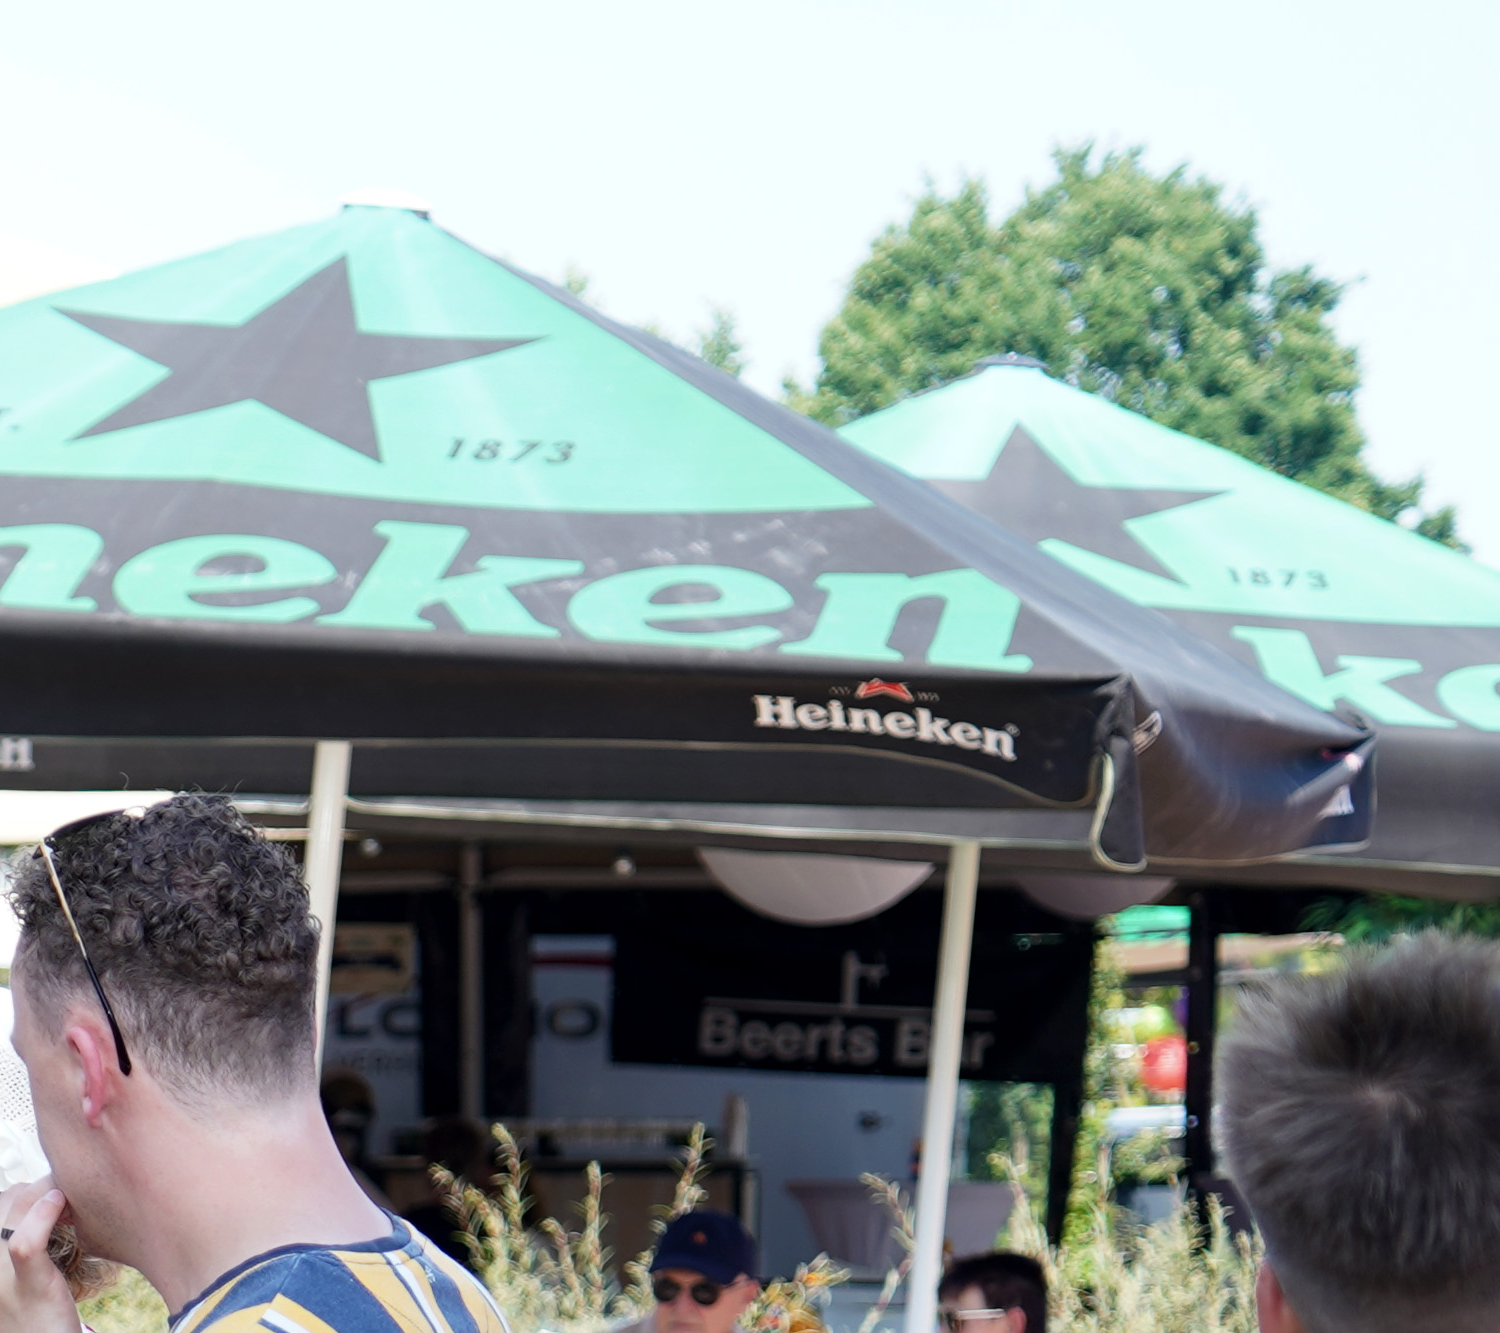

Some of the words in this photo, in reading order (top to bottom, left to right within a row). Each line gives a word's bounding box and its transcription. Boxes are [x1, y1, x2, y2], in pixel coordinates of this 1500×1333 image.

[447, 435, 577, 467] 1873
[1226, 566, 1332, 591] 1873
[752, 694, 1018, 762] Heineken
[700, 1007, 880, 1067] Beerts
[893, 1014, 996, 1071] Br
